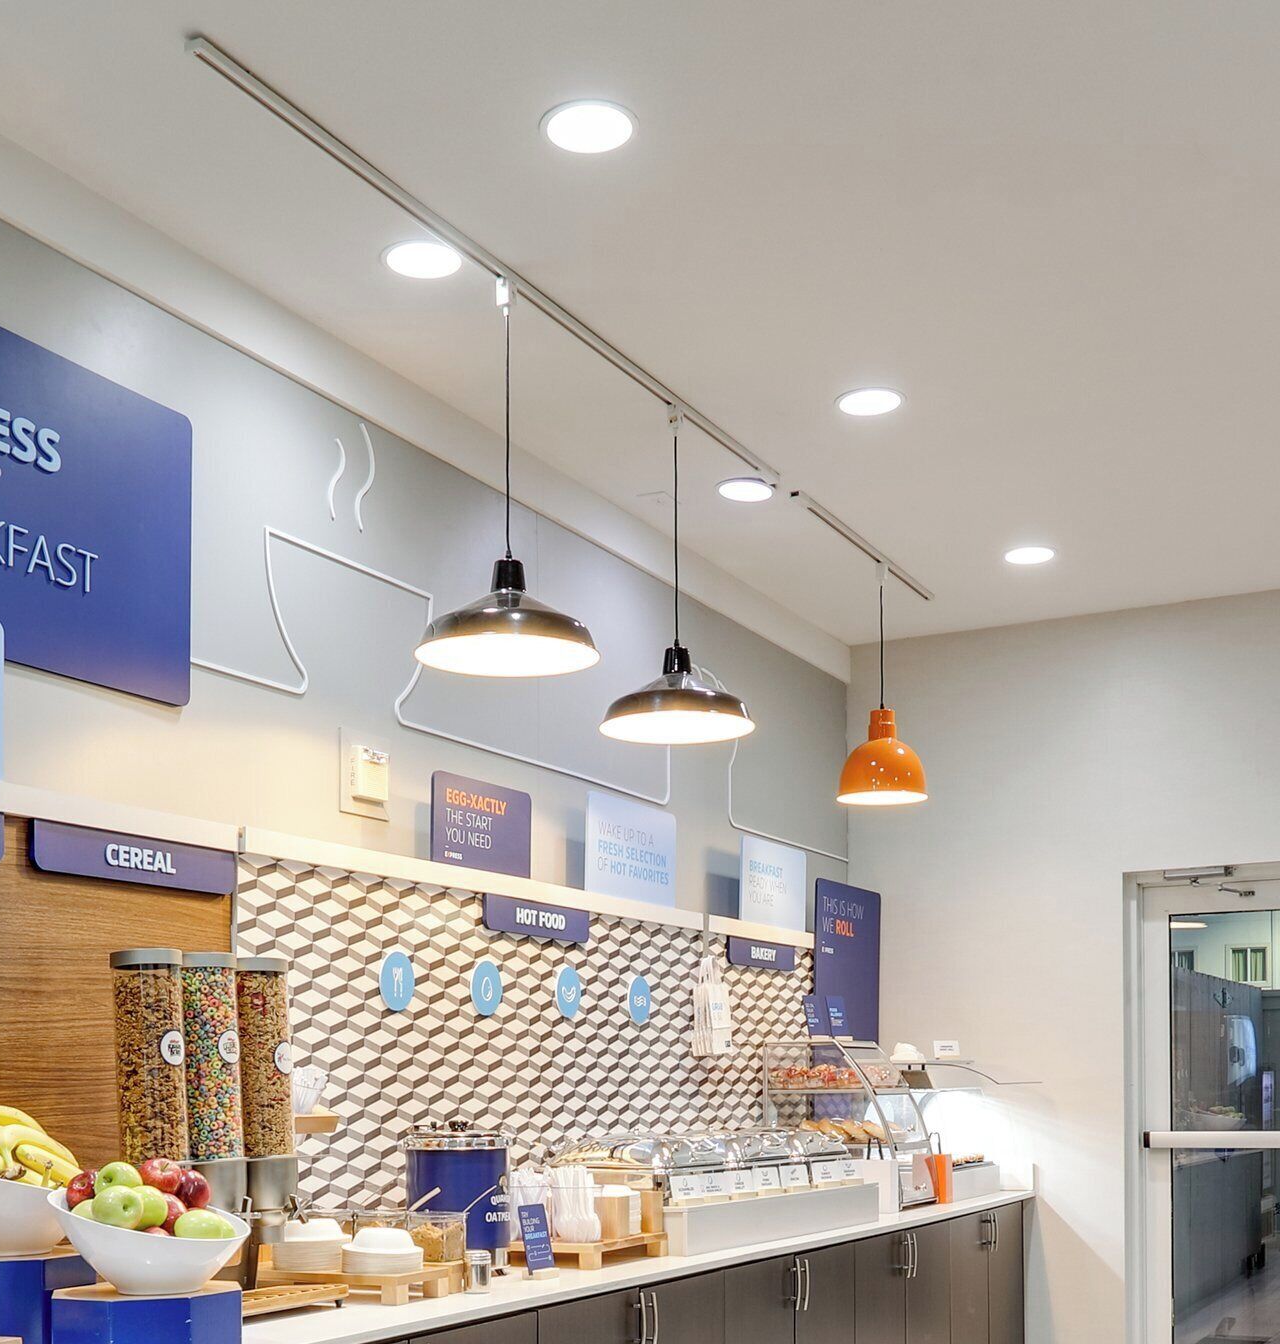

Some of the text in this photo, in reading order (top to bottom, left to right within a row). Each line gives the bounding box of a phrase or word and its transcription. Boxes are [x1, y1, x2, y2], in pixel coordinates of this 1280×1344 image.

[446, 787, 508, 816] EGG-XACTLY
[446, 807, 493, 832] THE START
[445, 826, 492, 850] YOU NEED
[598, 821, 654, 847] WAKE UP TO A
[105, 842, 177, 876] CEREAL
[598, 839, 667, 868] FRESH SELECTION
[597, 856, 670, 886] OF HOT FAVORITES
[748, 859, 783, 879] BREAKFAST
[516, 906, 566, 931] HOT FOOD
[823, 896, 865, 920] THIS IS HOW
[822, 916, 855, 938] WE ROLL
[750, 946, 777, 962] BAKERY
